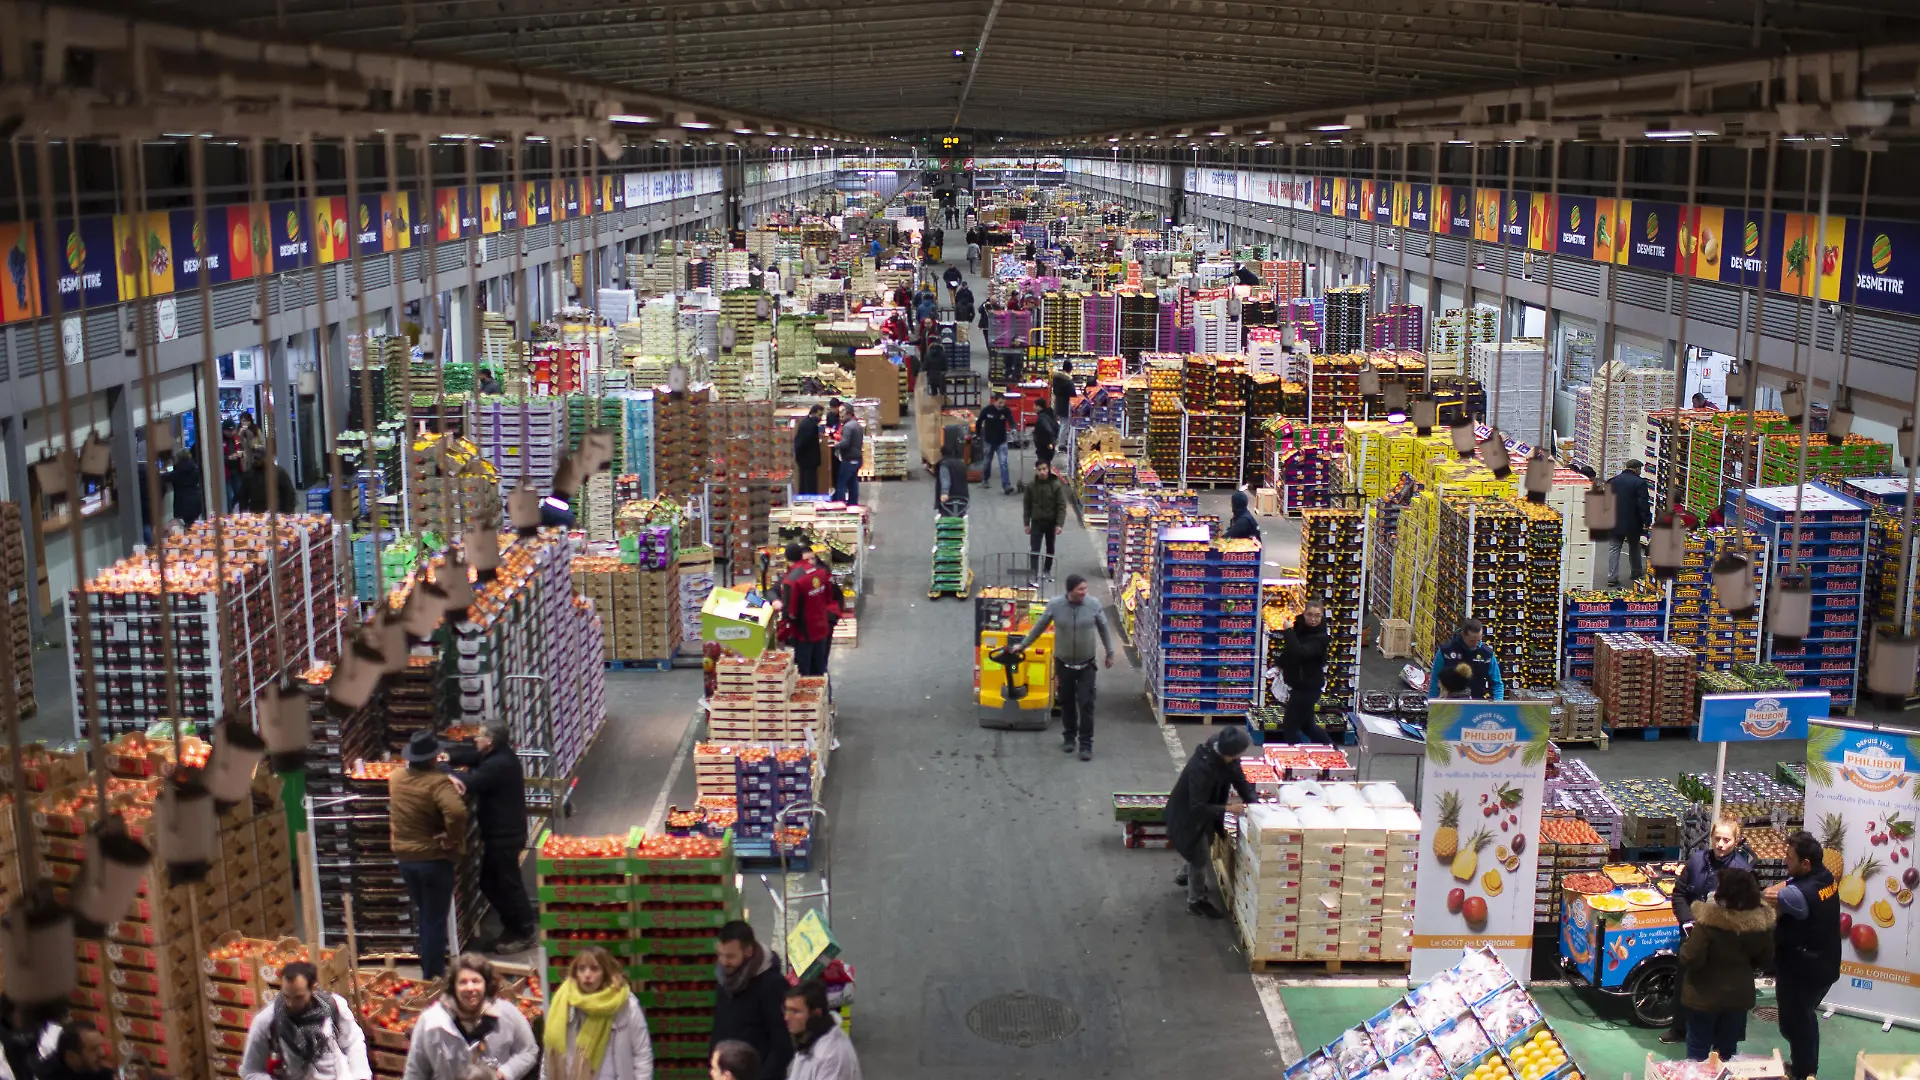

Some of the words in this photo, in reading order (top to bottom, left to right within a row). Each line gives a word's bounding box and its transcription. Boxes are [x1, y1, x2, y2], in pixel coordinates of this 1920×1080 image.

[908, 159, 926, 169] A2
[1563, 232, 1587, 246] DESMETTRE
[1636, 242, 1666, 258] DESMETTRE
[1856, 271, 1904, 294] DESMETTRE
[1830, 532, 1860, 541] Dinki
[1173, 552, 1205, 560] Dinki
[1223, 553, 1255, 561] Dinki
[1829, 548, 1858, 557] Dinki
[1172, 568, 1205, 577] Dinki
[1827, 564, 1857, 573] Dinki
[1222, 570, 1254, 578] Dinki
[1172, 585, 1204, 594] Dinki
[1827, 581, 1856, 590] Dinki
[1221, 586, 1254, 595] Dinki
[1171, 602, 1203, 611] Dinki
[1825, 598, 1855, 606] Dinki
[1579, 604, 1610, 612] Dinki
[1627, 603, 1658, 611] Dinki
[1824, 613, 1854, 622] Dinki
[1220, 620, 1252, 628] Dinki
[1578, 620, 1609, 628] Dinki
[1823, 630, 1853, 639] Dinki
[1169, 636, 1202, 645] Dinki
[1219, 637, 1251, 645] Dinki
[1822, 646, 1852, 654] Dinki
[1821, 662, 1850, 670] Dinki
[1169, 668, 1201, 677] Dinki
[1218, 669, 1250, 678] Dinki
[1819, 678, 1849, 686] Dinki
[1168, 701, 1200, 709] Dinki
[1749, 712, 1784, 720] PHILIBON
[1464, 731, 1513, 741] PHILIBON
[1855, 738, 1877, 748] DEPUIS
[1847, 754, 1901, 769] PHILIBON
[1441, 937, 1463, 946] GOÛT
[1476, 939, 1515, 947] L'ORIGINE
[1853, 967, 1864, 975] de
[1866, 969, 1910, 983] L'ORIGINE
